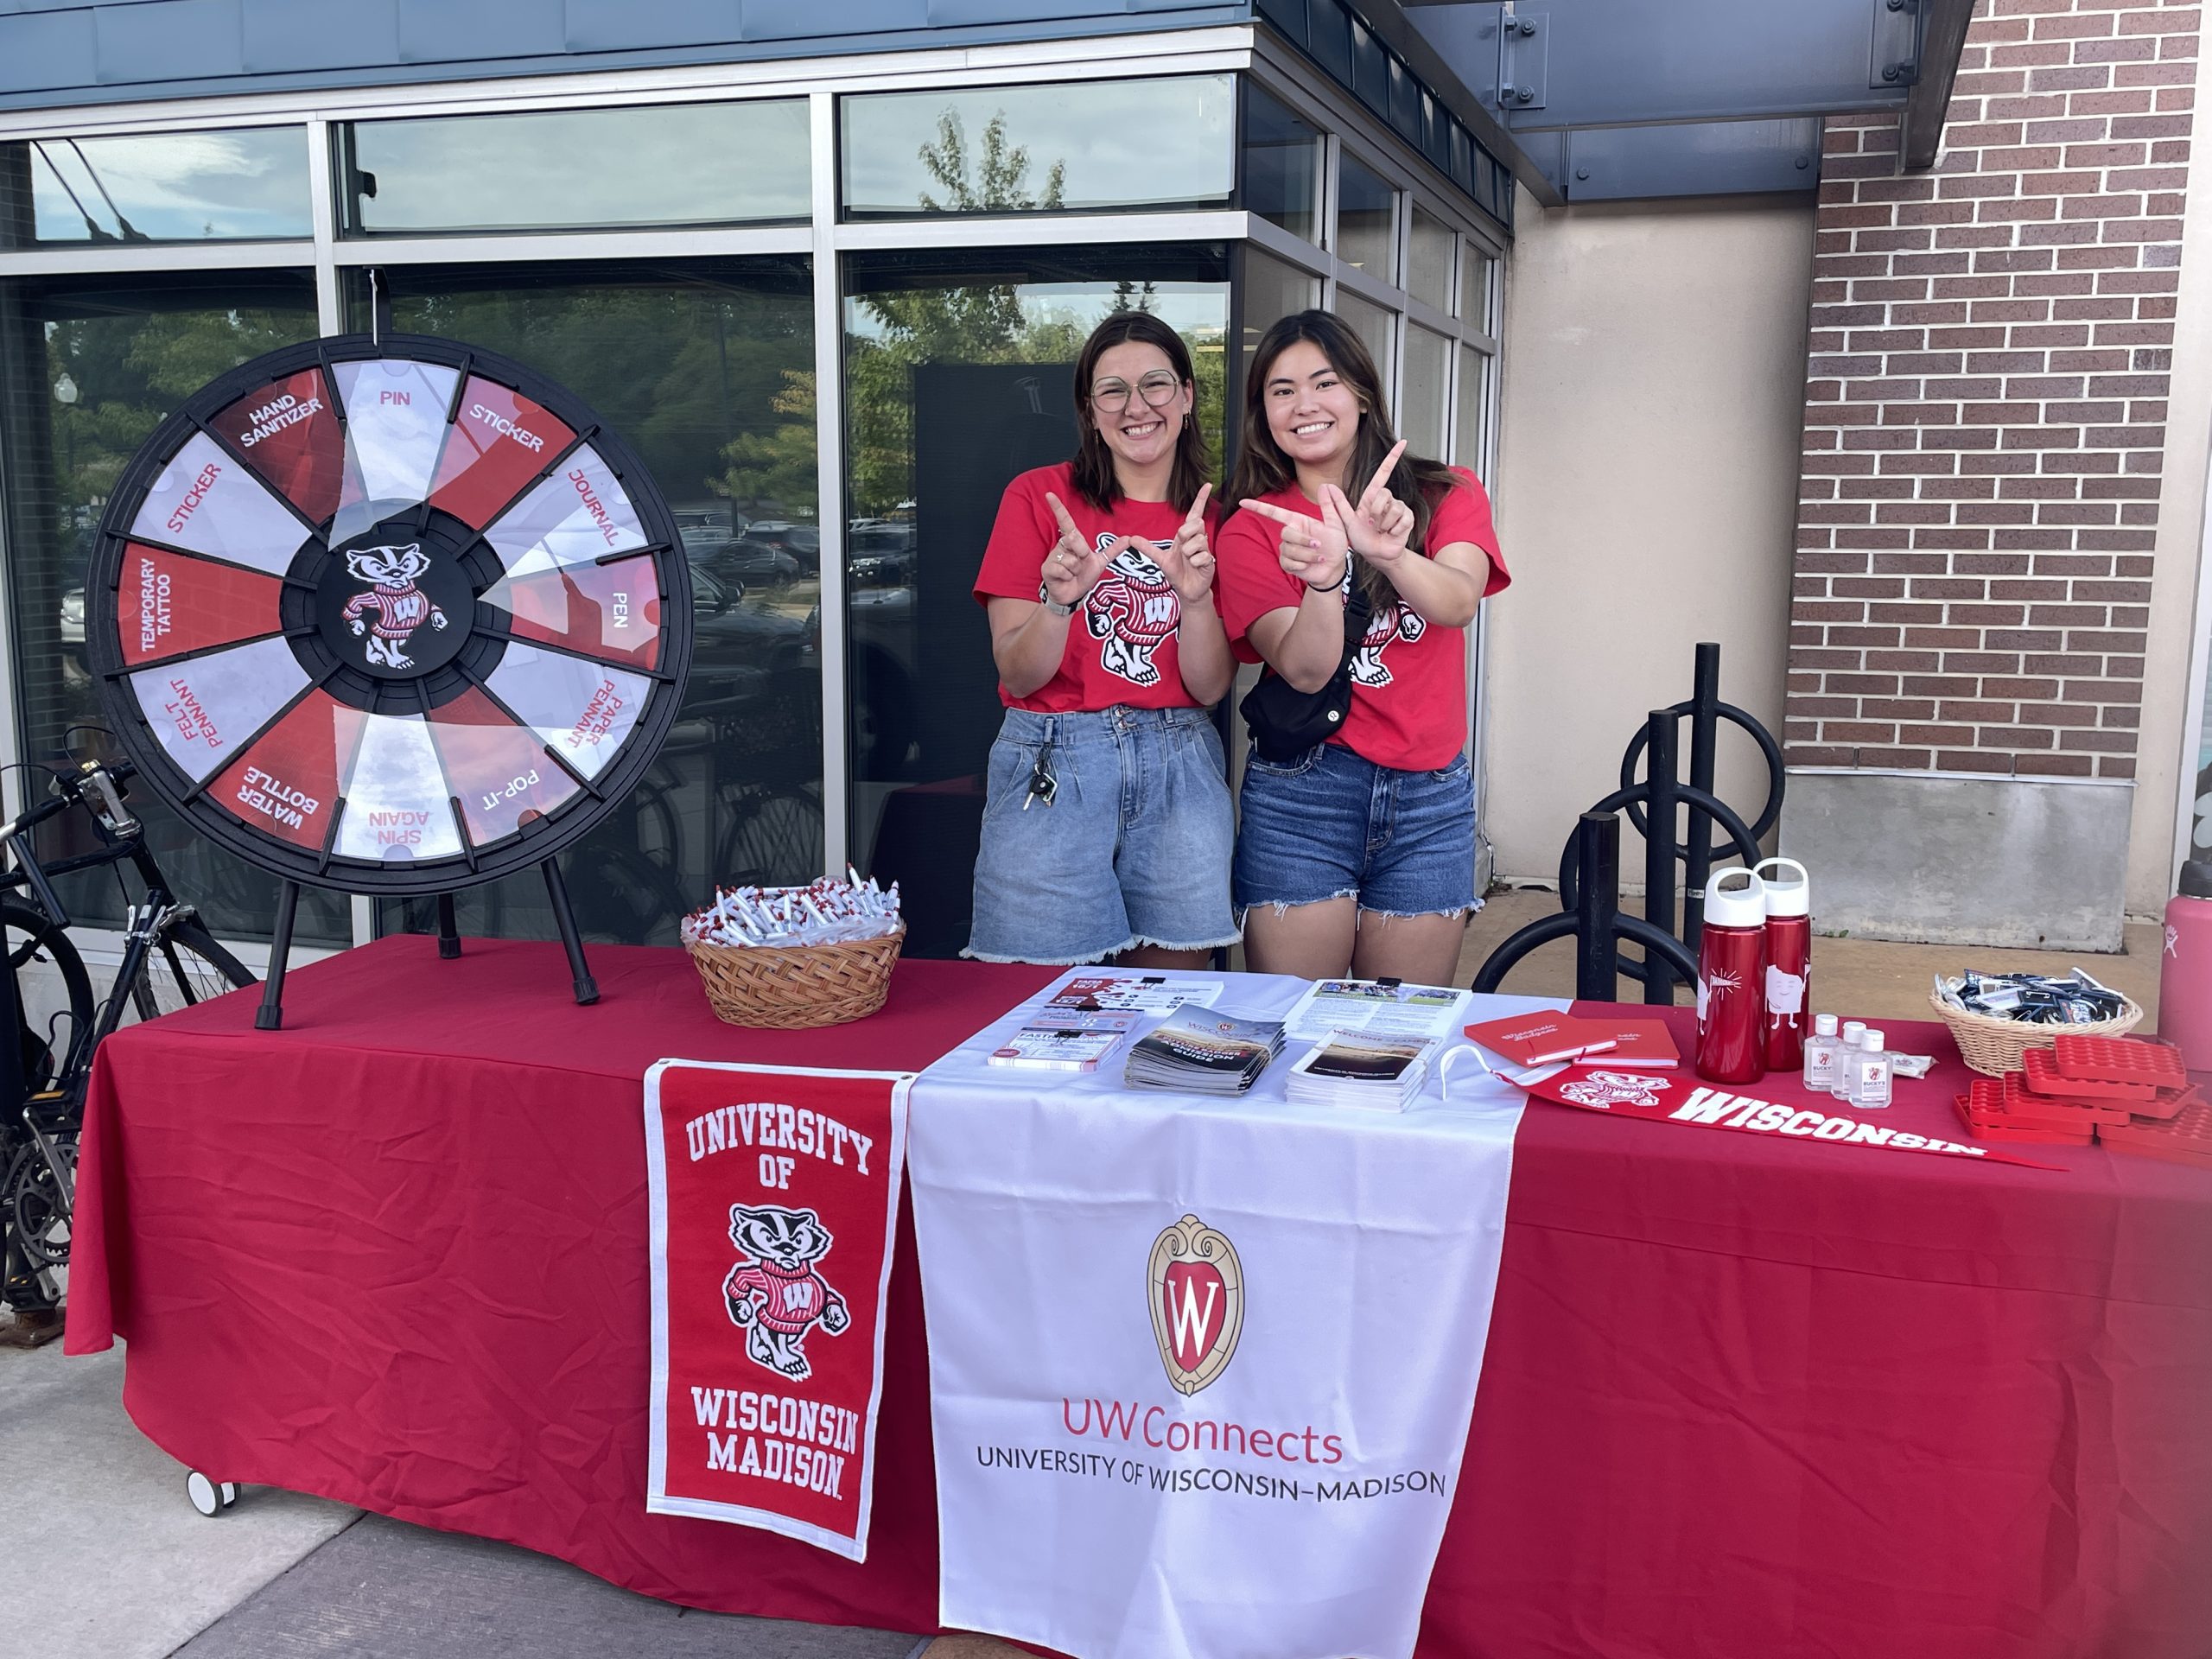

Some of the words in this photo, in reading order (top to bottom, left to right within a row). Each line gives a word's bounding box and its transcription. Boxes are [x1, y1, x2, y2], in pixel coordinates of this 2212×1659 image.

[240, 397, 324, 448] SANITIZER
[249, 394, 296, 425] HAND
[379, 391, 410, 405] PIN
[469, 404, 544, 453] STICKER
[167, 463, 221, 533] STICKER
[568, 469, 621, 547] JOURNAL
[141, 558, 156, 652] TEMPORARY
[156, 574, 171, 636] TATTOO
[613, 592, 629, 628] PEN
[165, 702, 199, 741] FELT
[170, 678, 223, 748] PENNANT
[568, 678, 615, 748] PENNANT
[588, 696, 623, 747] PAPER
[237, 785, 303, 830] WATER
[243, 766, 319, 815] BOTTLE
[482, 769, 540, 811] POP-IT
[369, 811, 429, 827] AGAIN
[378, 830, 422, 845] SPIN
[1188, 1021, 1252, 1038] WISCONSIN
[1173, 1048, 1215, 1063] GUIDE
[686, 1103, 874, 1177] UNIVERSITY
[1668, 1086, 1988, 1156] WISCONSIN
[759, 1153, 796, 1190] OF
[1167, 1275, 1219, 1358] W
[690, 1386, 859, 1454] WISCONSIN
[707, 1432, 845, 1499] MADISON
[976, 1445, 1116, 1478] UNIVERSITY
[1122, 1460, 1145, 1485] OF
